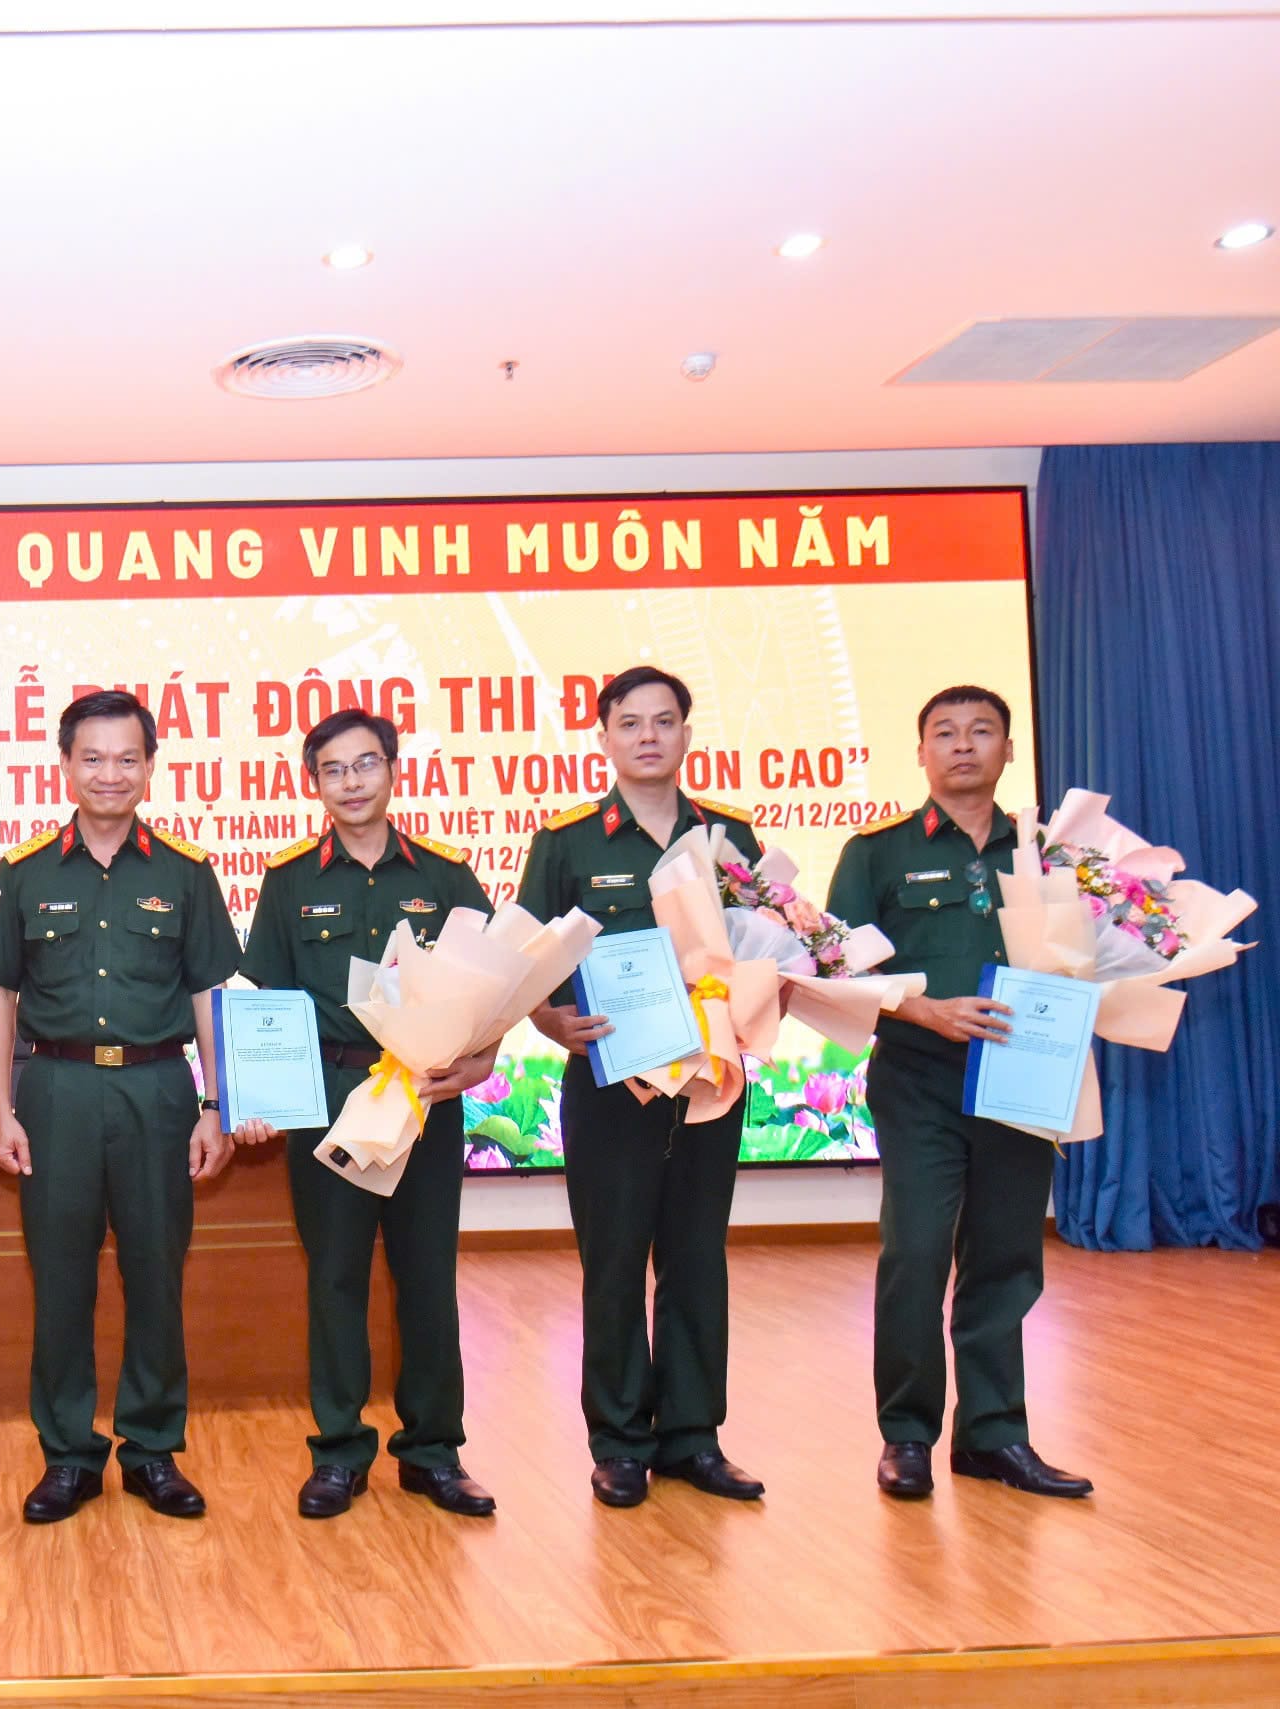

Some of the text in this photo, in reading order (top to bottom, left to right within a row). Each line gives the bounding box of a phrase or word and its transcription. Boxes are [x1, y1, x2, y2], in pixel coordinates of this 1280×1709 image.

[17, 530, 263, 589] QUANG
[300, 525, 470, 578] VINH
[506, 510, 702, 574] MUÔN
[738, 505, 890, 568] NĂM
[439, 675, 536, 733] THI
[168, 756, 223, 811] TỰ
[394, 749, 476, 798] HÁT
[491, 752, 609, 804] VỌNG
[758, 746, 870, 790] CAO”
[213, 810, 297, 841] THÀNH
[439, 806, 495, 839] VIỆT
